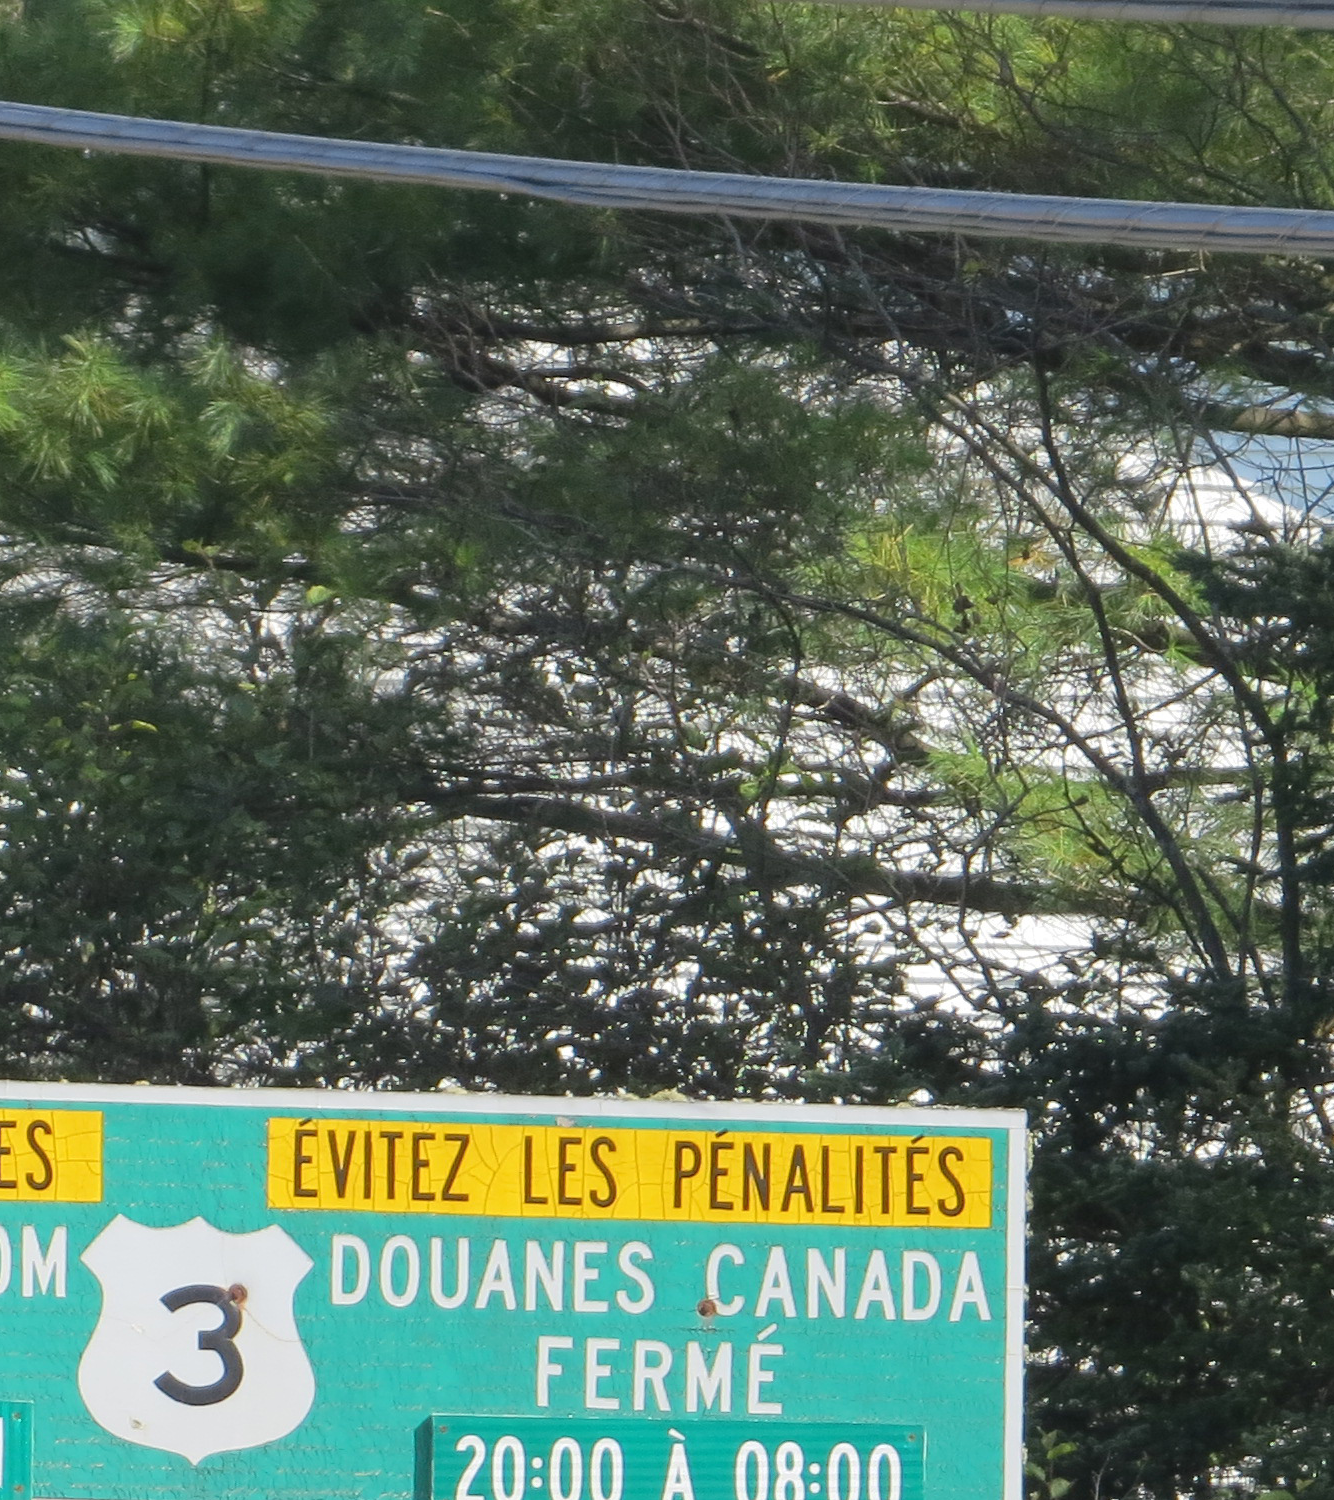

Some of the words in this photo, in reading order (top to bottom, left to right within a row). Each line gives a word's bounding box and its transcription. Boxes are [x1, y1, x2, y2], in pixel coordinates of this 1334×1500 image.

[293, 1119, 469, 1202] ÉVITEZ
[524, 1136, 617, 1207] LES
[674, 1129, 966, 1217] PÉNALITÉS
[330, 1234, 655, 1315] DOUANES
[705, 1243, 992, 1322] CANADA
[153, 1284, 244, 1406] 3
[536, 1324, 784, 1416] FERMÉ
